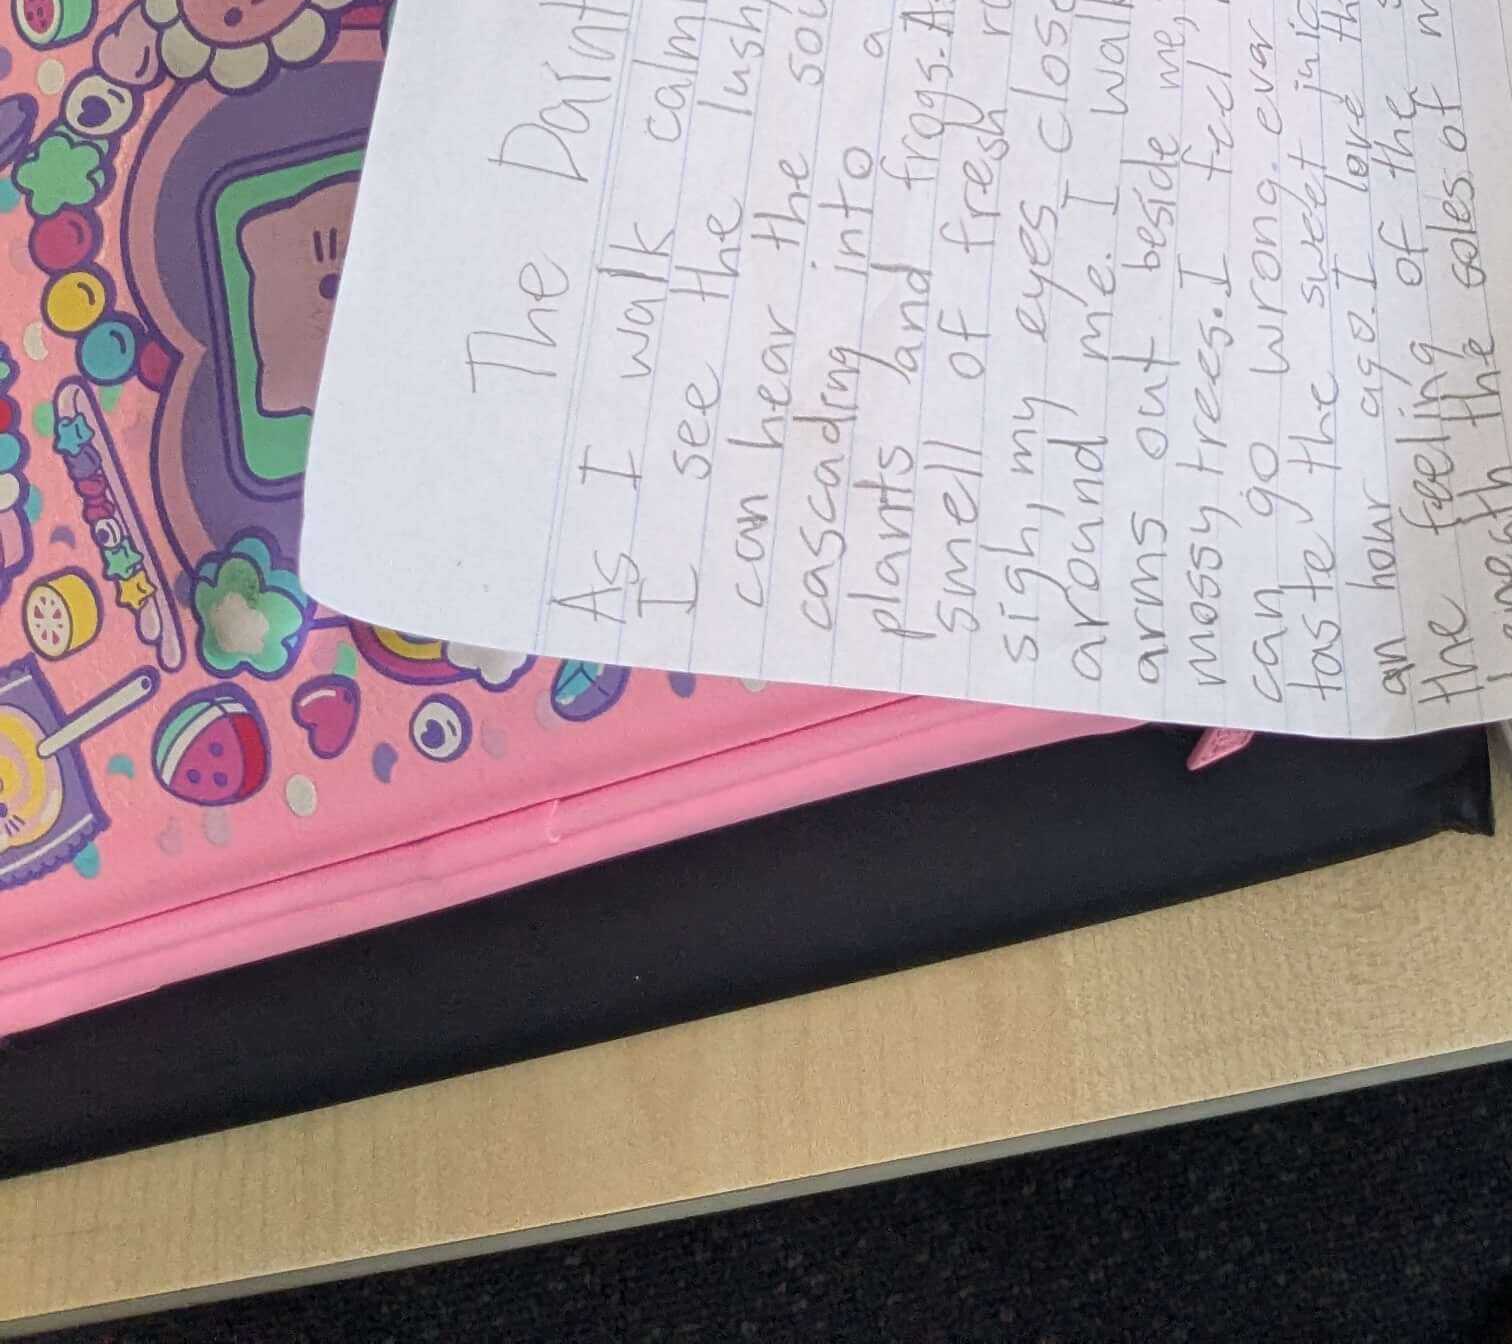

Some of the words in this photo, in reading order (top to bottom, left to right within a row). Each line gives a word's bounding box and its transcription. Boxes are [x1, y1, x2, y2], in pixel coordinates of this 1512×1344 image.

[863, 27, 893, 59] a
[1155, 13, 1201, 89] me,
[1248, 16, 1284, 135] ever
[879, 45, 986, 190] frogs.
[1179, 58, 1234, 181] feel
[1323, 91, 1369, 192] love
[1369, 84, 1421, 179] the
[1409, 81, 1468, 151] of
[750, 151, 810, 251] the
[811, 144, 874, 275] into
[943, 106, 1010, 255] fresh
[1061, 177, 1121, 216] I
[1119, 133, 1179, 272] beside
[1286, 135, 1329, 309] sweet
[1424, 176, 1487, 289] soles
[595, 220, 676, 378] walk
[668, 197, 740, 302] the
[1015, 199, 1088, 343] eyes
[1083, 250, 1119, 360] me.
[1177, 251, 1231, 297] I
[1334, 250, 1376, 290] I
[1380, 218, 1427, 288] of
[463, 251, 570, 393] The
[869, 262, 933, 373] and
[940, 306, 991, 379] of
[1347, 304, 1412, 419] ago.
[671, 359, 722, 479] see
[725, 302, 799, 450] hear
[1110, 336, 1181, 460] out
[1175, 306, 1233, 474] trees.
[1286, 369, 1342, 474] the
[1439, 332, 1503, 426] the
[576, 442, 644, 490] I
[791, 343, 912, 630] cascading
[1006, 394, 1081, 475] my
[1243, 440, 1312, 523] go
[1394, 338, 1466, 535] feeling
[546, 548, 641, 624] As
[730, 493, 770, 606] can
[846, 440, 937, 638] plants
[921, 438, 984, 633] smell
[979, 500, 1069, 663] sigh,
[1046, 434, 1110, 681] around
[1345, 476, 1396, 589] hour
[638, 563, 699, 618] I
[1132, 509, 1169, 684] arms
[1188, 501, 1244, 685] mossy
[1250, 586, 1284, 703] can
[1277, 531, 1345, 700] taste
[1372, 636, 1415, 697] an
[1418, 592, 1486, 703] the
